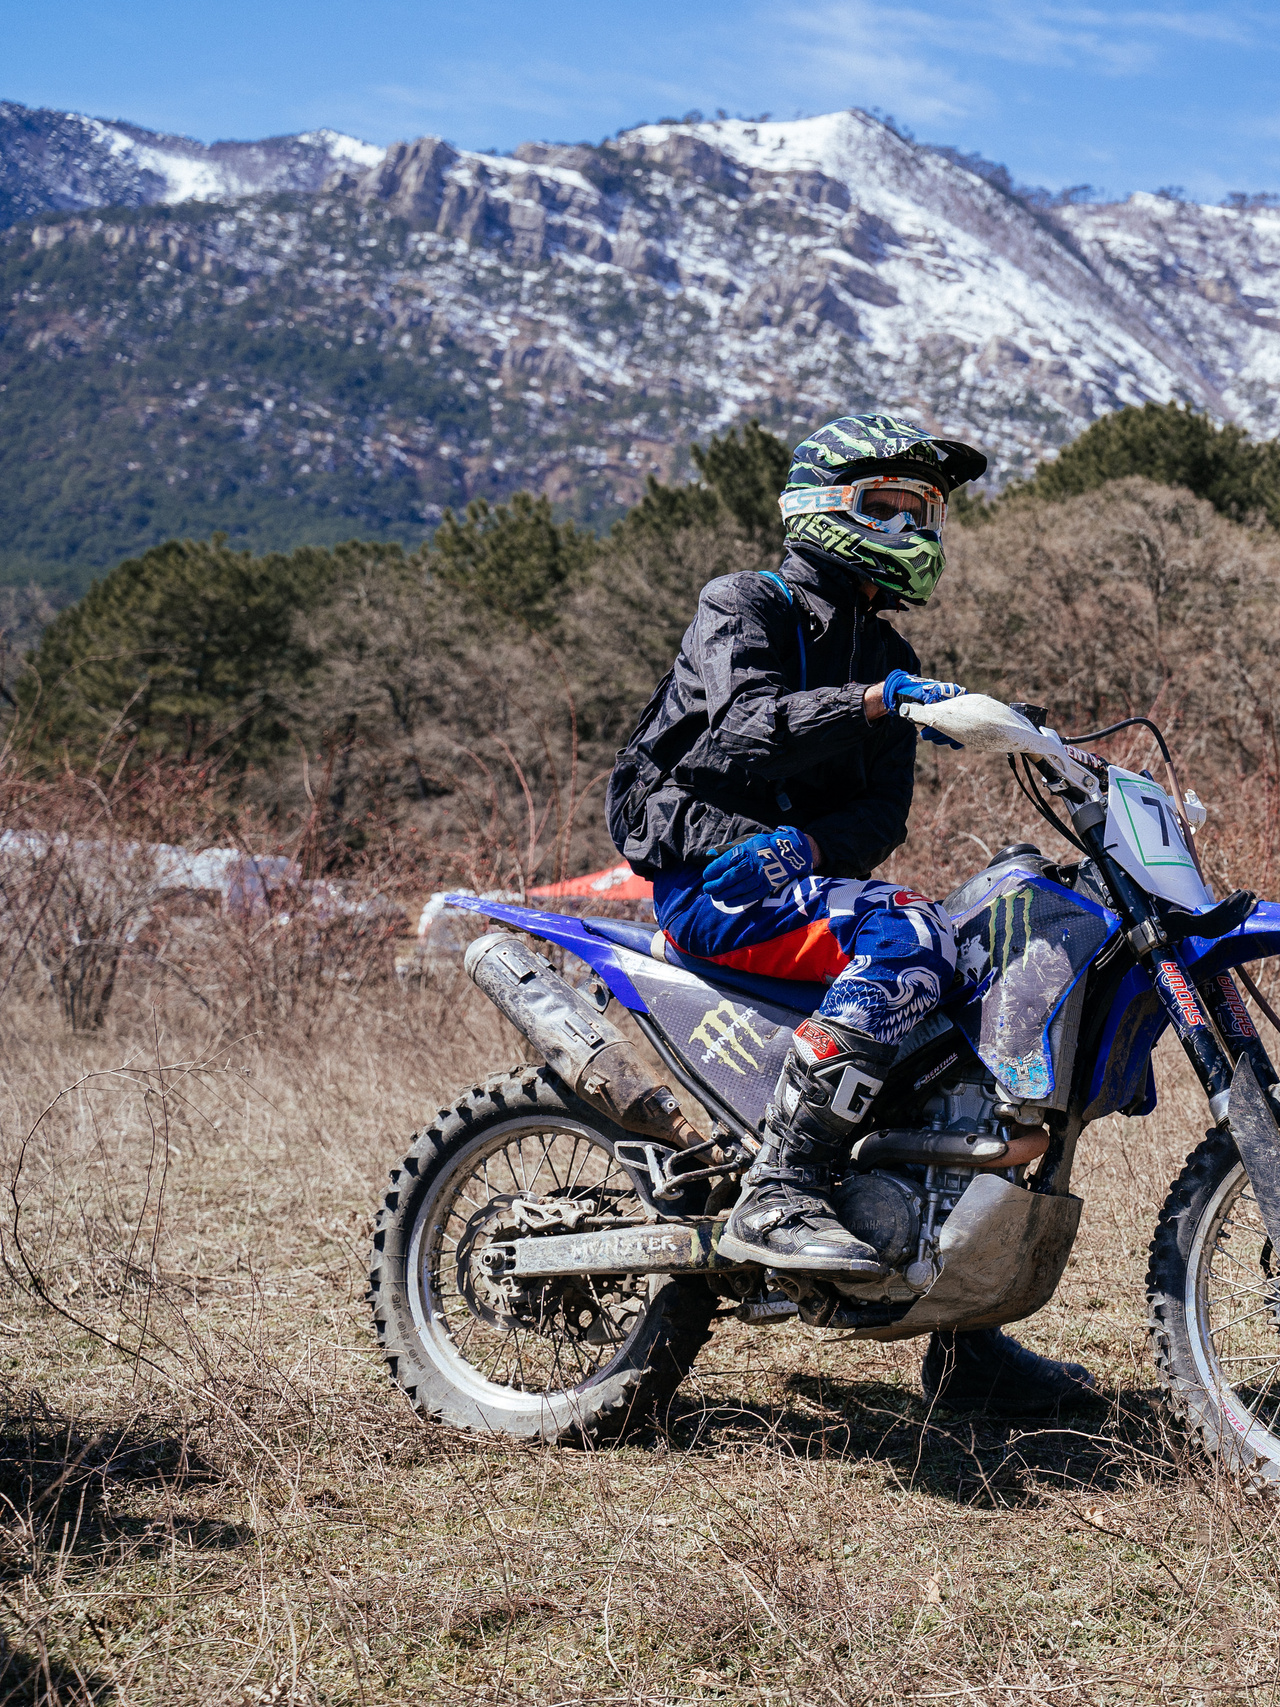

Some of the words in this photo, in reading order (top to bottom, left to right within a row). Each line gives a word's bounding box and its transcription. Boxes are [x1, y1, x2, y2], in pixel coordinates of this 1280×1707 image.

[757, 848, 790, 894] FOX
[1161, 962, 1205, 1026] SHOWA
[1217, 976, 1257, 1037] SHOWA
[701, 1007, 758, 1064] MONSTER
[900, 1013, 949, 1058] MAHA
[924, 1052, 958, 1081] RENTHAL
[831, 1065, 884, 1123] G
[571, 1235, 677, 1262] MSTER
